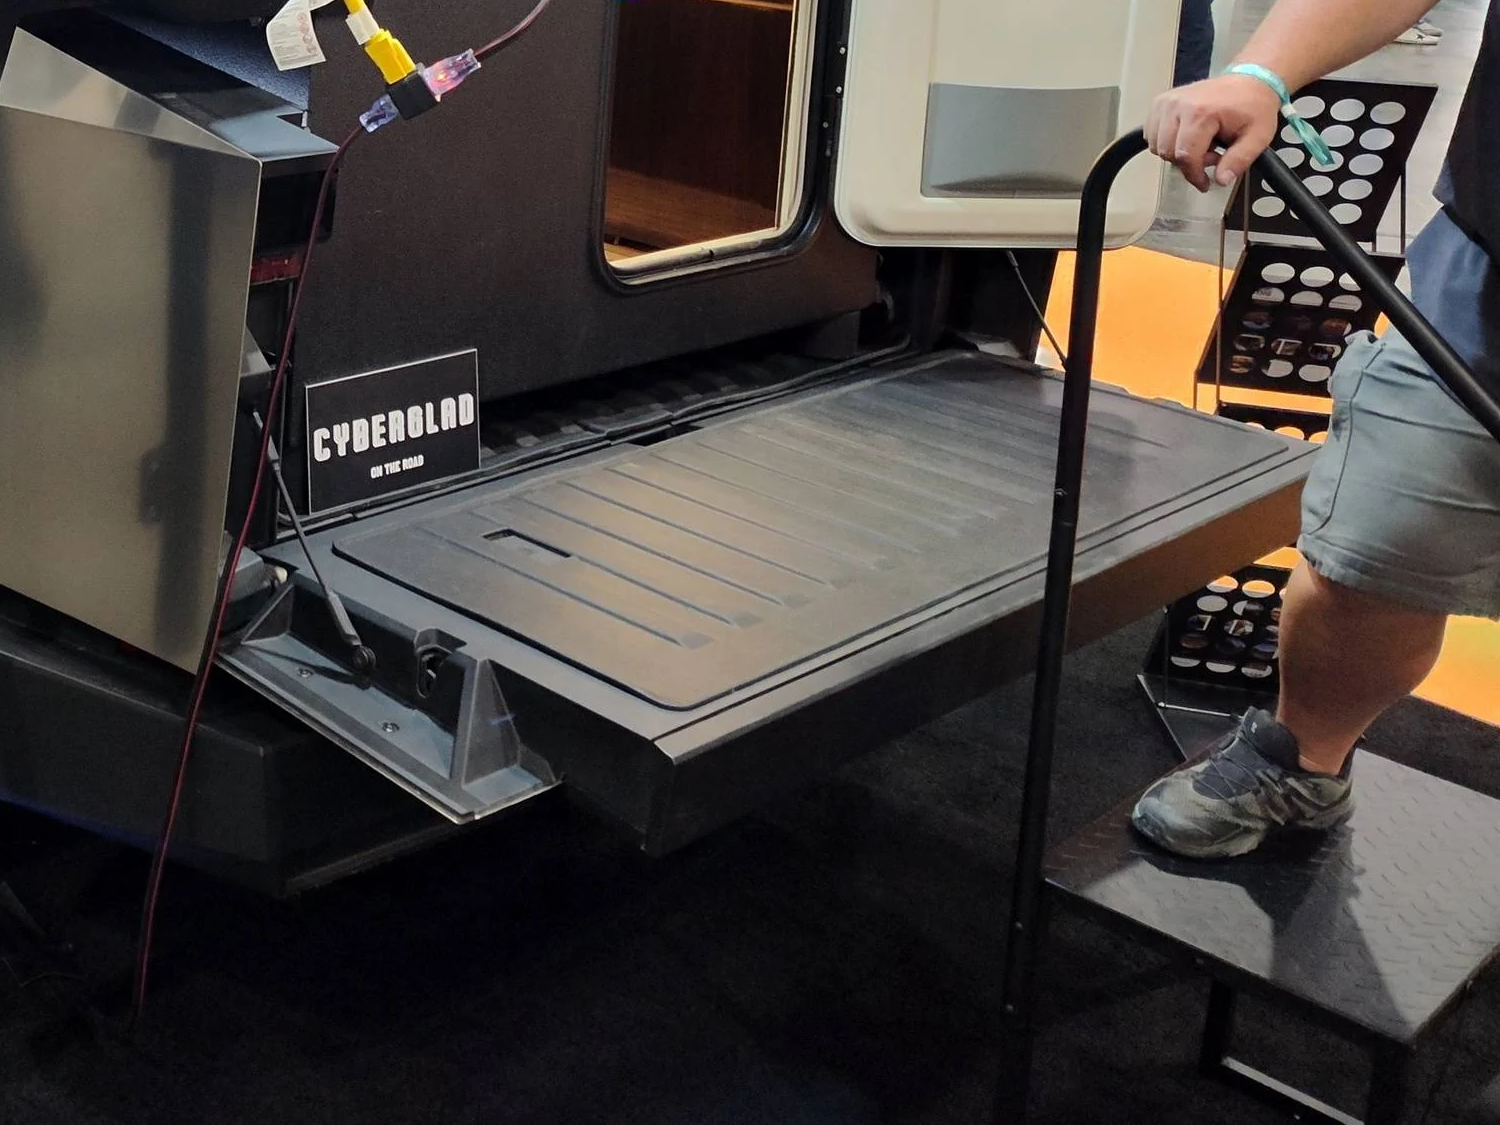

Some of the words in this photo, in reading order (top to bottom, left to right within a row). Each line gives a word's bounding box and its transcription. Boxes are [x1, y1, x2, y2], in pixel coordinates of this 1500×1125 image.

[370, 465, 383, 479] ON
[384, 460, 402, 475] THE
[402, 454, 425, 471] ROAD
